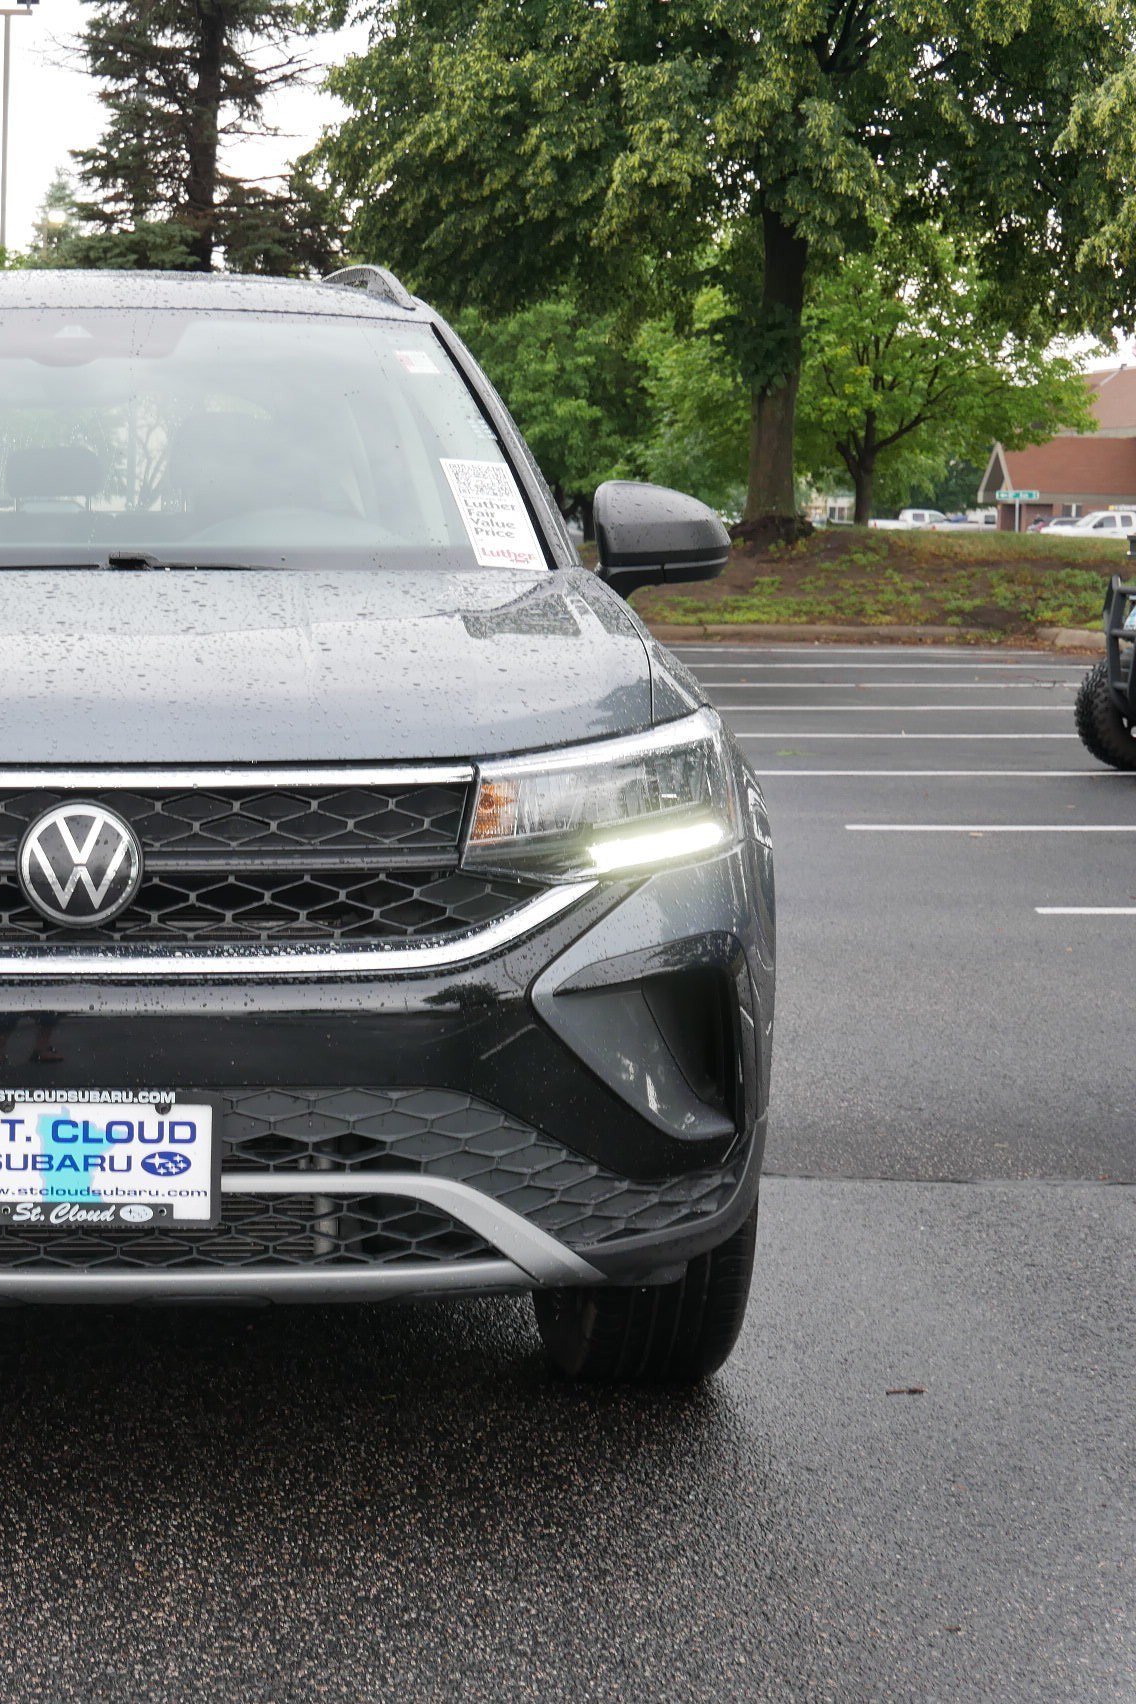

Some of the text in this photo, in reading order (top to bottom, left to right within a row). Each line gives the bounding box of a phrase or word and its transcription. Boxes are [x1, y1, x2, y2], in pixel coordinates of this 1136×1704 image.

[464, 499, 516, 511] Luther
[467, 508, 495, 518] Fair
[470, 517, 516, 529] Value
[474, 526, 516, 538] Price
[481, 547, 535, 561] Luther
[51, 1119, 197, 1144] CLOUD
[12, 1202, 116, 1224] St. Cloud
